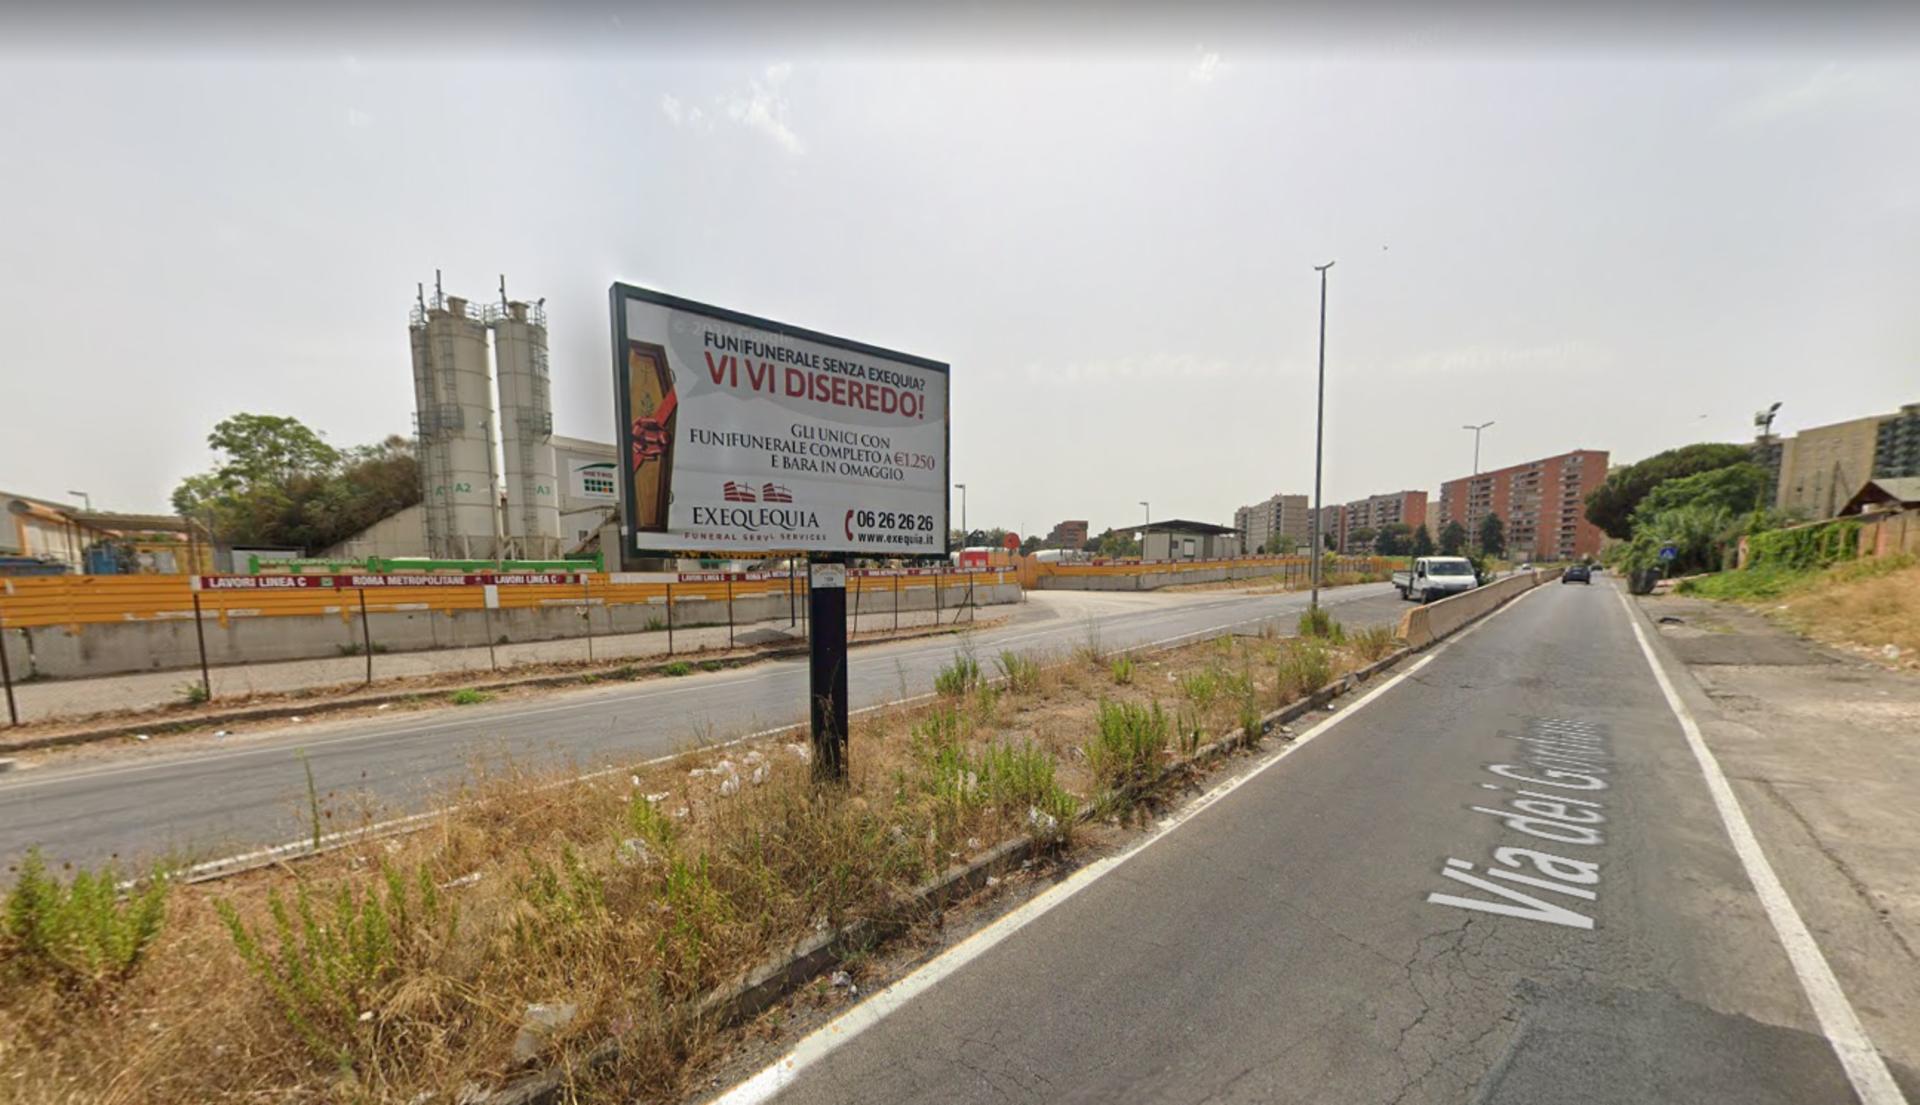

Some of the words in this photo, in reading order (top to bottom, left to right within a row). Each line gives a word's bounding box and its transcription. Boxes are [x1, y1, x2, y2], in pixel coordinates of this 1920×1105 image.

[704, 331, 820, 369] FUNIFUNERALE
[823, 357, 866, 379] SENZA
[868, 367, 926, 392] EXEQUIA?
[704, 351, 738, 388] VI
[744, 358, 775, 394] VI
[785, 367, 925, 420] DISEREDO!
[791, 423, 815, 440] GLI
[818, 426, 858, 446] UNICI
[861, 434, 891, 449] CON
[690, 428, 808, 456] FUNIFUNERALE
[809, 442, 882, 465] COMPLETO
[883, 452, 892, 466] A
[893, 450, 936, 471] €1.250
[771, 454, 780, 468] E
[783, 456, 818, 472] BARA
[821, 459, 836, 474] IN
[839, 462, 905, 481] OMAGGIO.
[455, 482, 472, 493] A2
[857, 510, 875, 528] 06
[878, 512, 895, 529] 26
[898, 513, 914, 530] 26
[917, 514, 933, 531] 26
[684, 531, 737, 541] FUNERAL
[858, 533, 934, 546] www.exequia.it
[208, 577, 256, 588] LAVORI
[259, 577, 295, 587] LINEA
[297, 577, 307, 587] C
[352, 576, 386, 586] ROMA
[387, 574, 466, 586] METROPOLITANE
[494, 575, 524, 585] LAVORI
[526, 575, 549, 584] LINEA
